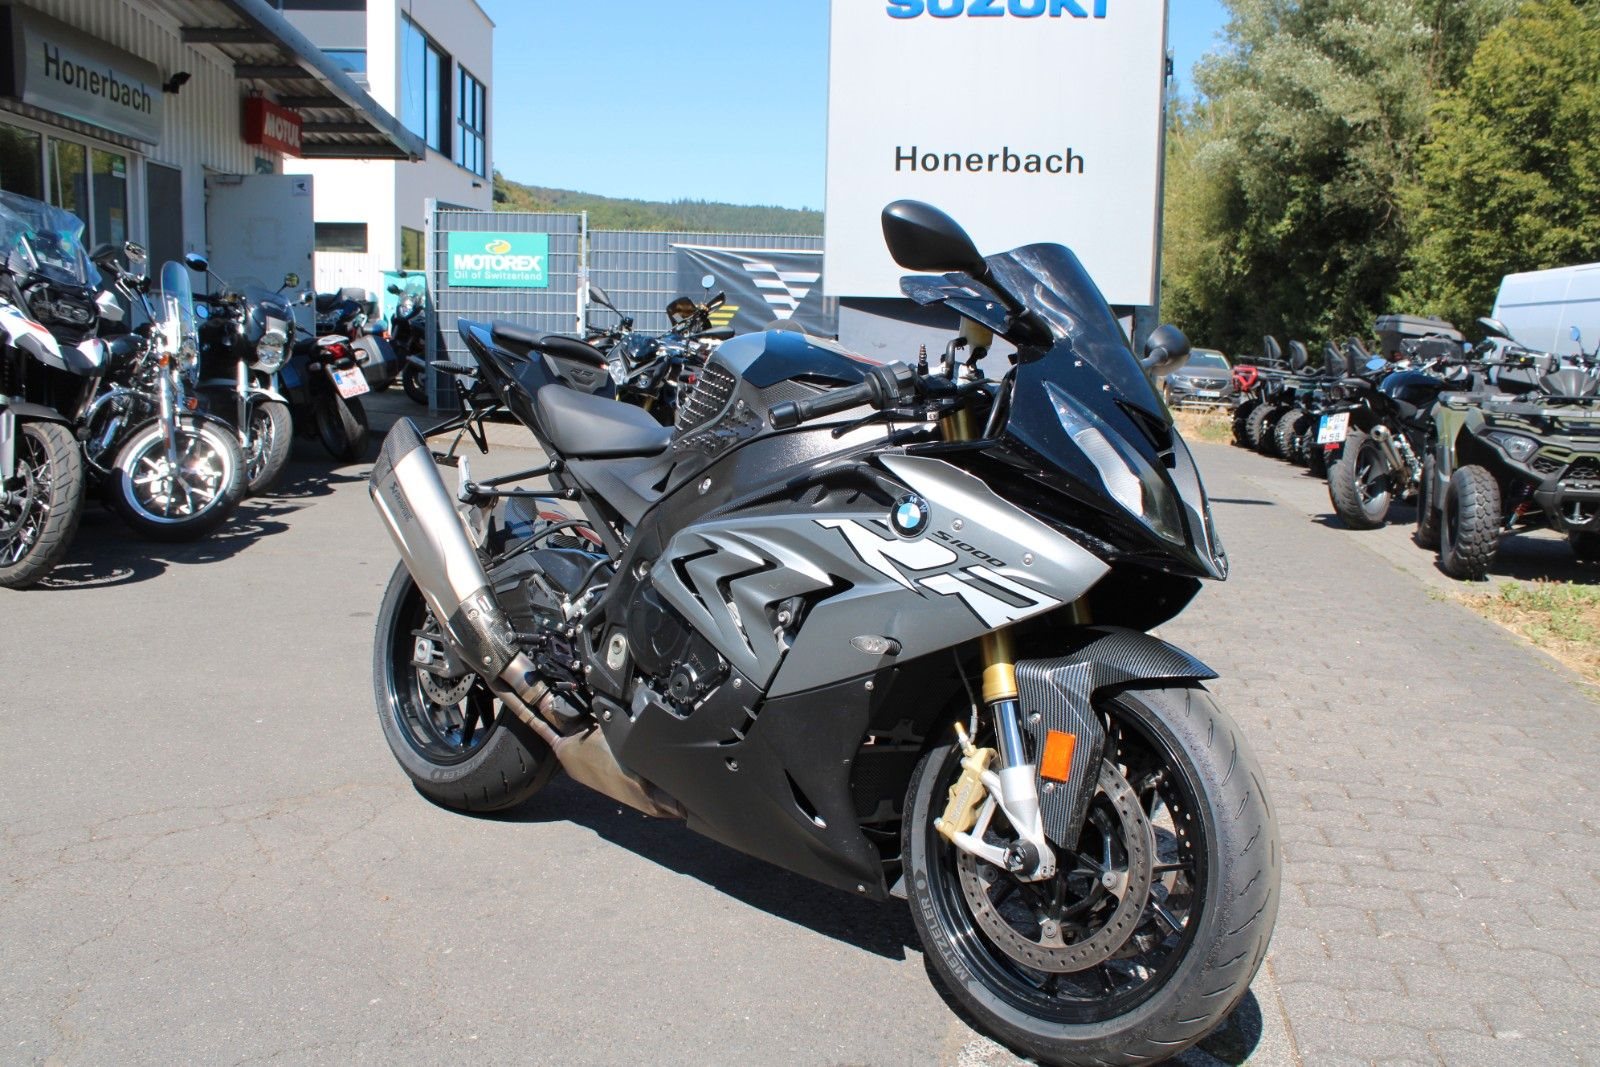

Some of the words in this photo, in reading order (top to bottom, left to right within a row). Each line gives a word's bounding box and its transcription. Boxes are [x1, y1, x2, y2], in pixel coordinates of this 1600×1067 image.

[43, 42, 151, 115] Honerbach
[263, 111, 301, 149] MOTUL
[895, 146, 1084, 174] Honerbach
[454, 254, 544, 271] MOTOREX
[454, 271, 468, 279] Oil
[471, 271, 482, 280] of
[485, 271, 543, 281] Switzerland
[897, 496, 928, 513] BMW
[931, 530, 1007, 568] S1000
[920, 897, 968, 981] METZELER
